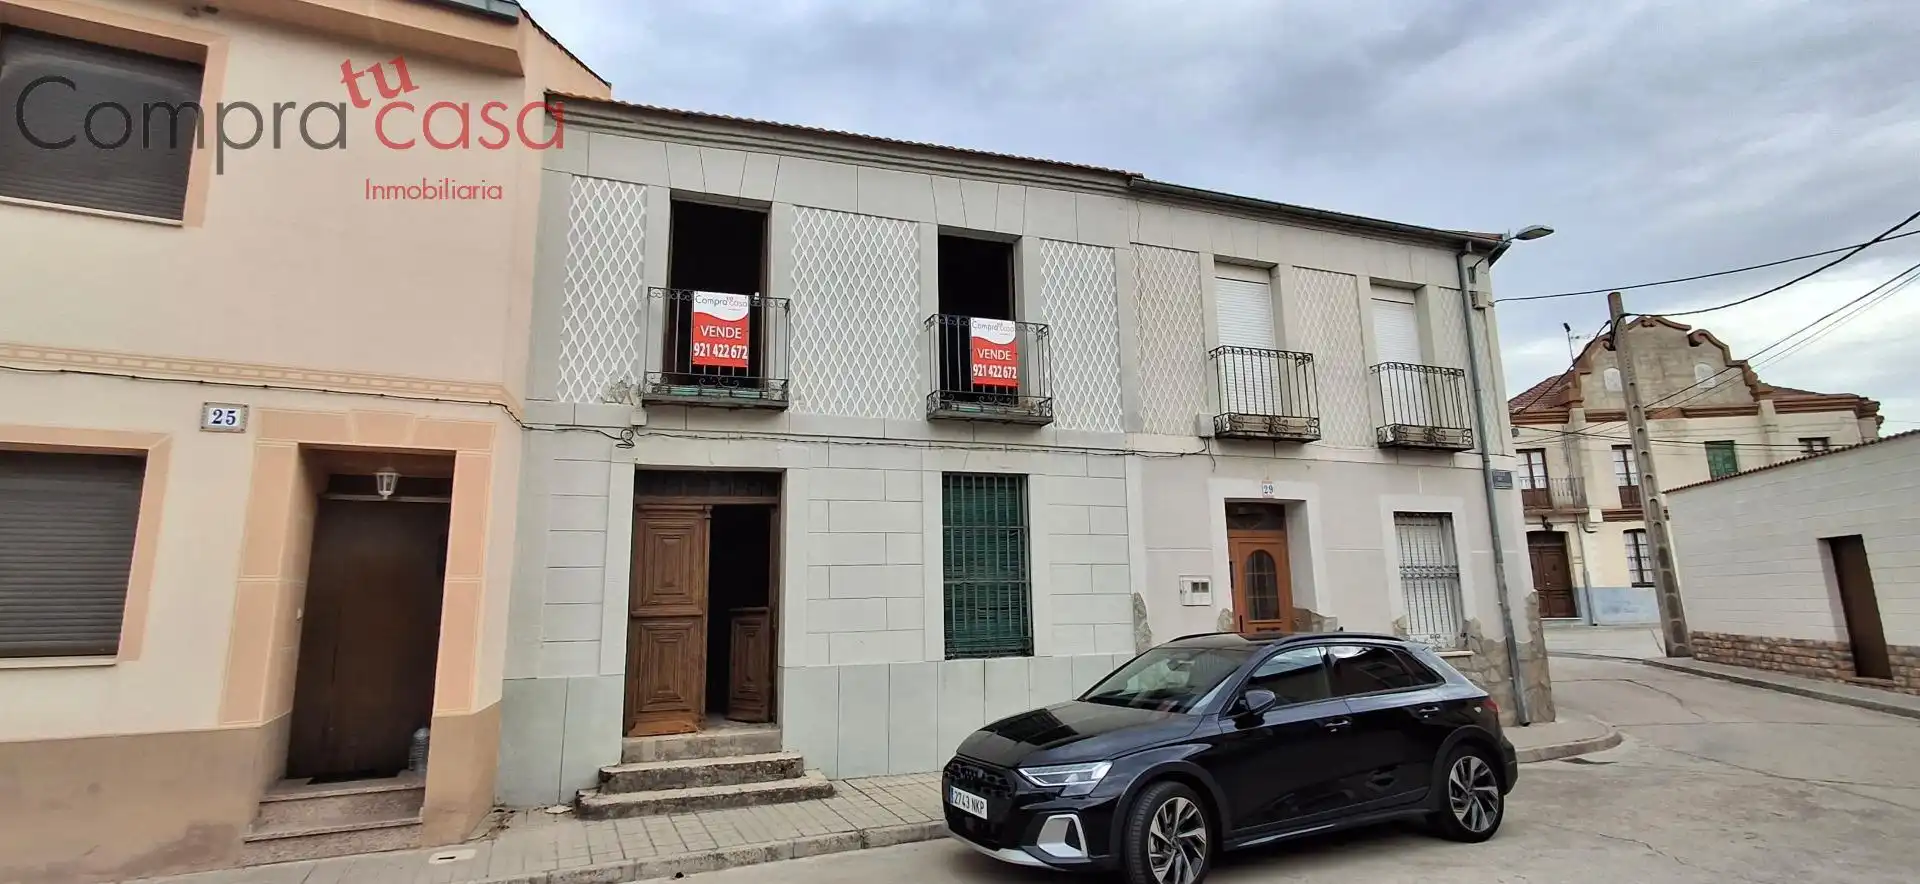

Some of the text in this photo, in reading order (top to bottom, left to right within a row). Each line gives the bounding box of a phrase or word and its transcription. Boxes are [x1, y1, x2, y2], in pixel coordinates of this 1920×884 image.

[695, 294, 728, 307] Compra
[700, 325, 742, 339] VENDE
[693, 342, 748, 359] 921 422 672
[976, 348, 1012, 361] VENDE
[973, 363, 1017, 379] 921 422 672
[211, 409, 236, 426] 25
[1263, 484, 1274, 494] 29
[955, 790, 985, 813] 2743 NKP
